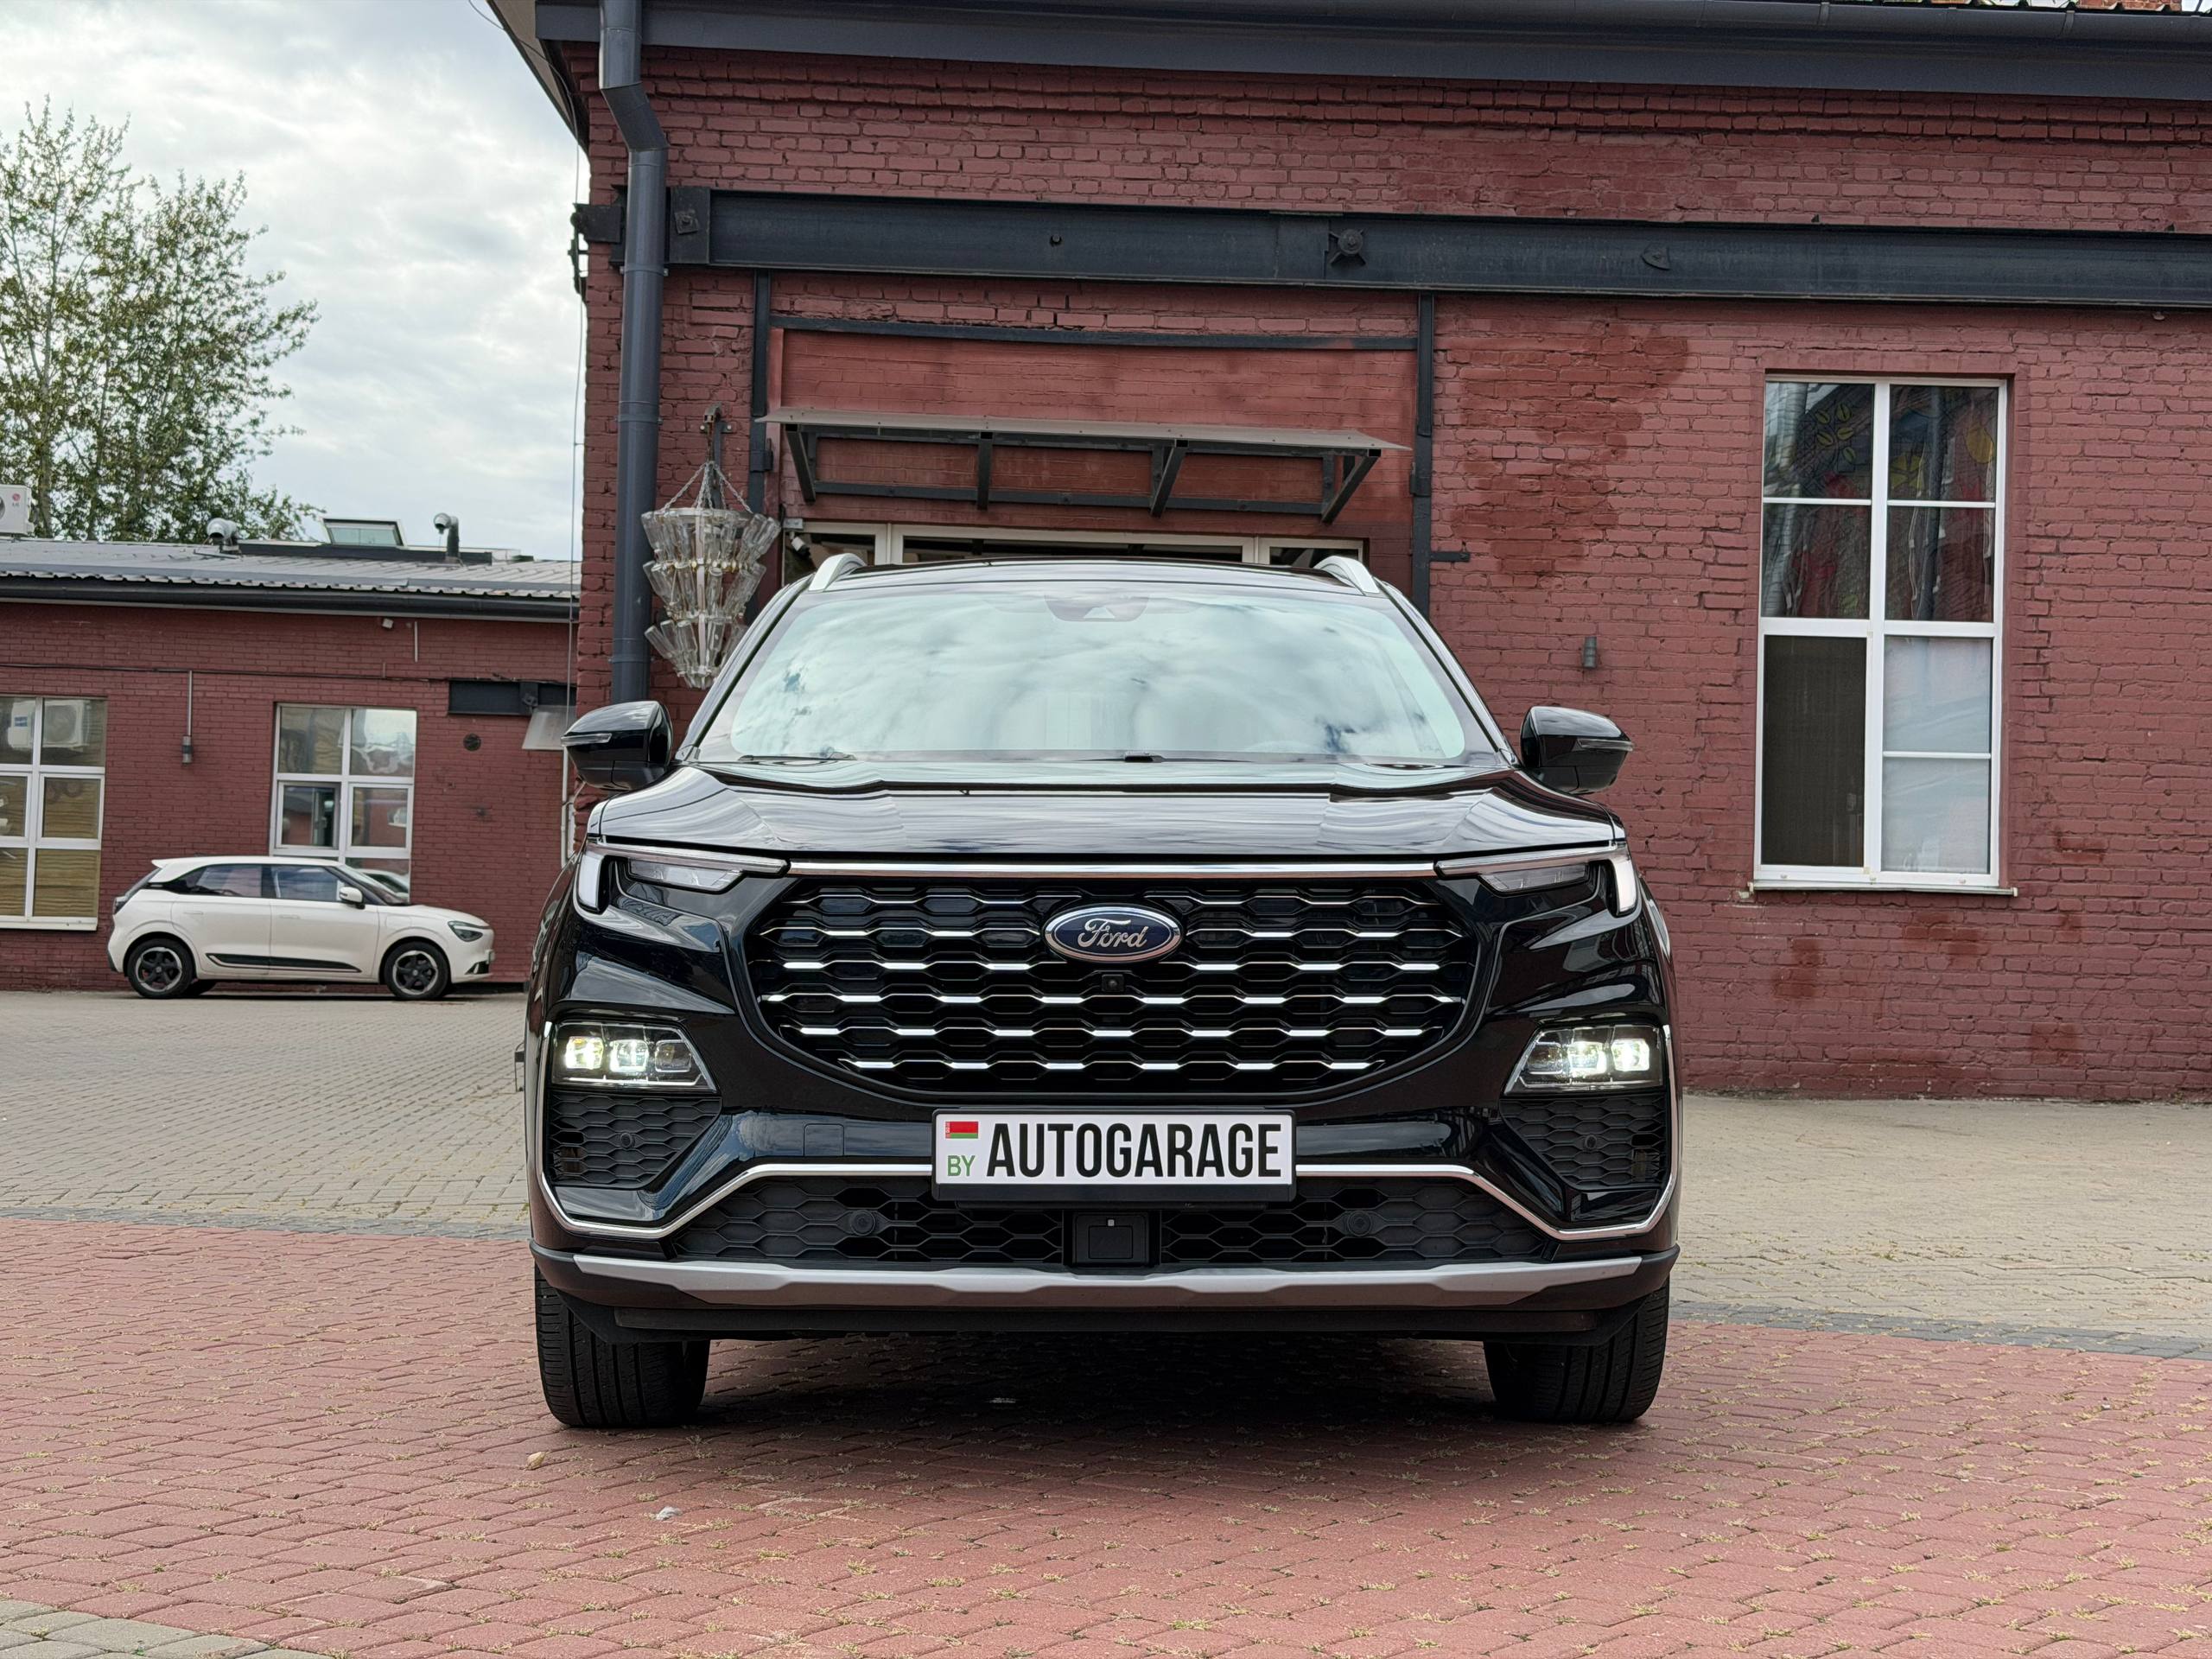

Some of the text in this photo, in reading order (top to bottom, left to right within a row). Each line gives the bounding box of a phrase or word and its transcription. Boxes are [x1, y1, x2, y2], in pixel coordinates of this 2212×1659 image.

[1077, 918, 1149, 948] Ford
[947, 1122, 1281, 1178] BY AUTOGARAGE
